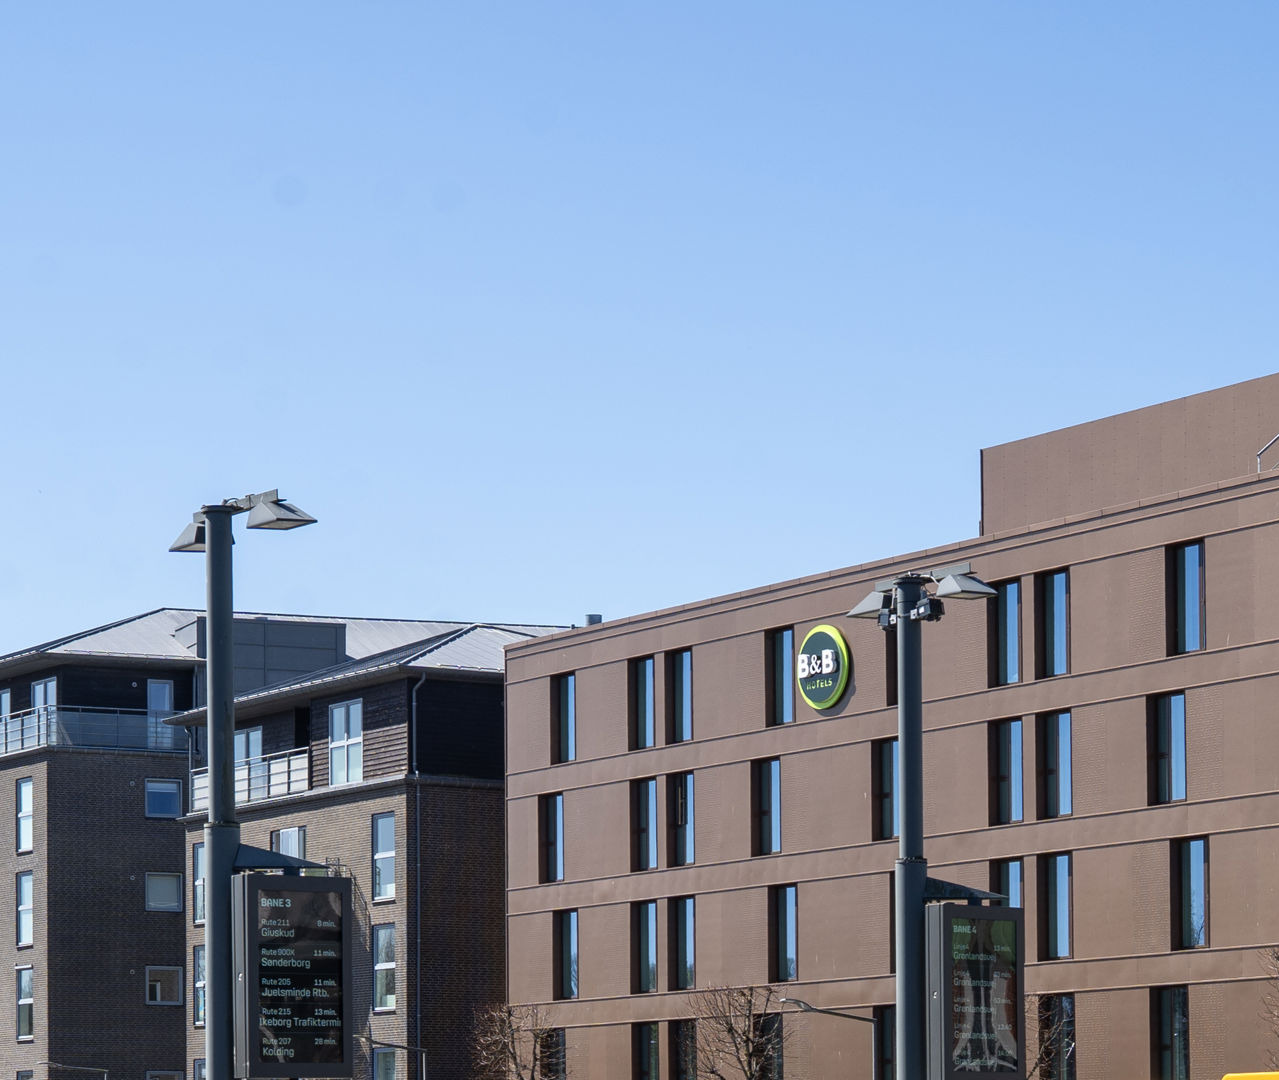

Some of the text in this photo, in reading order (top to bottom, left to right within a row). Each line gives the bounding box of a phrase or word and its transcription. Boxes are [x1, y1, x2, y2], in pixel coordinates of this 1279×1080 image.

[798, 649, 836, 679] B&B
[806, 678, 833, 690] HOTELS
[261, 898, 292, 908] BANE 3
[261, 948, 277, 956] Rute
[261, 957, 311, 969] Sønderborg
[261, 987, 329, 997] Juelsminde Rtb.
[262, 1007, 278, 1015] Rute
[262, 1037, 278, 1045] Rute
[262, 1047, 294, 1058] Kolding
